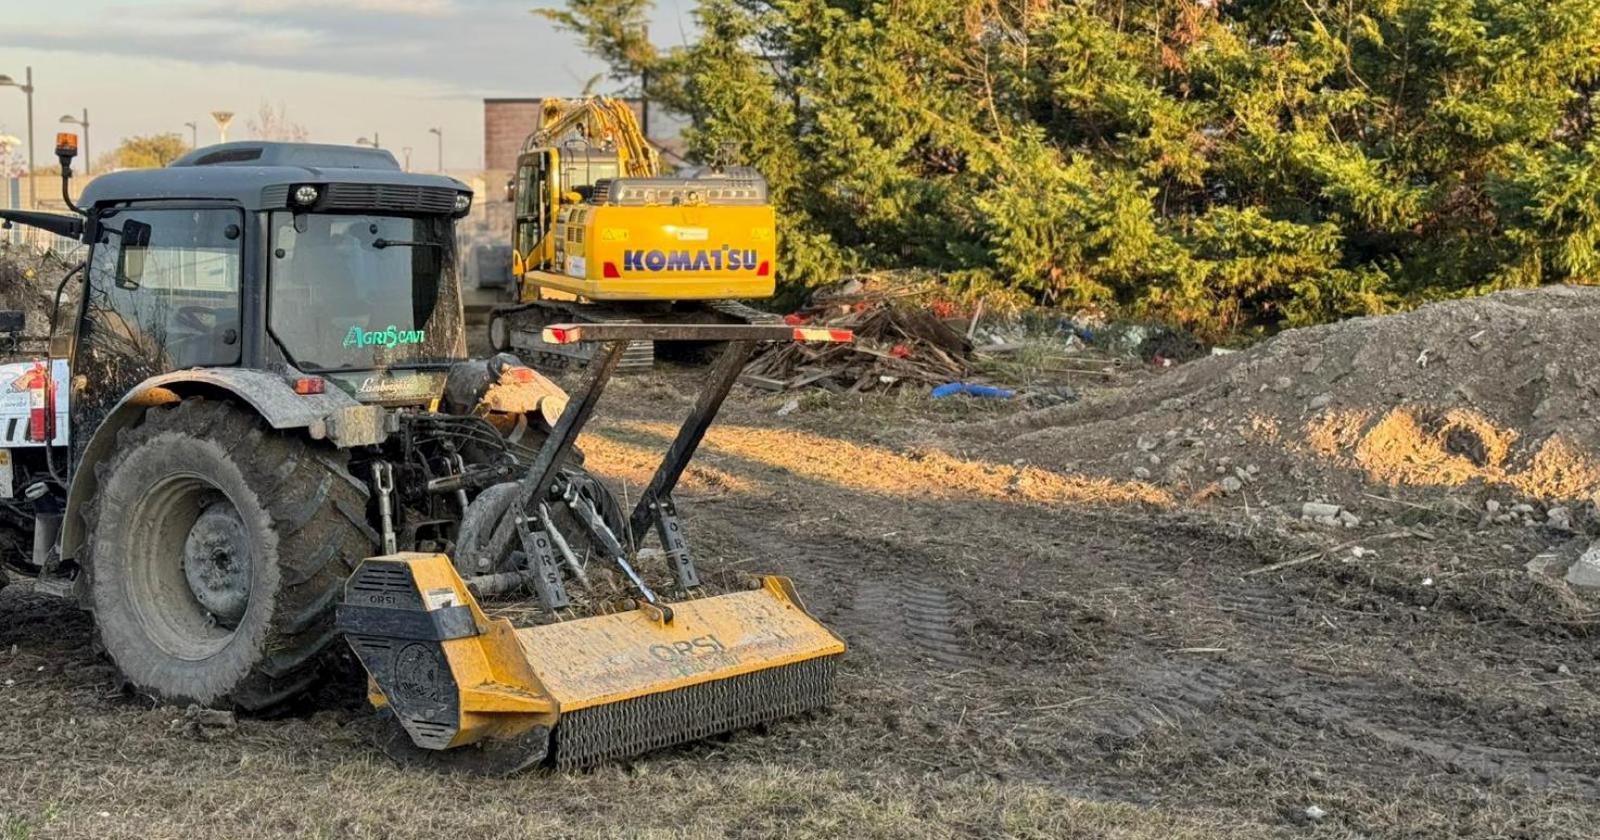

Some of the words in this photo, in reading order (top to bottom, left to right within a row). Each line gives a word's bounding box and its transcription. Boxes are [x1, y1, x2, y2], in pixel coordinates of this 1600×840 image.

[623, 245, 757, 272] KOMATSU
[536, 538, 560, 600] ORSI
[669, 522, 692, 580] ORSI
[370, 595, 396, 604] ORSI
